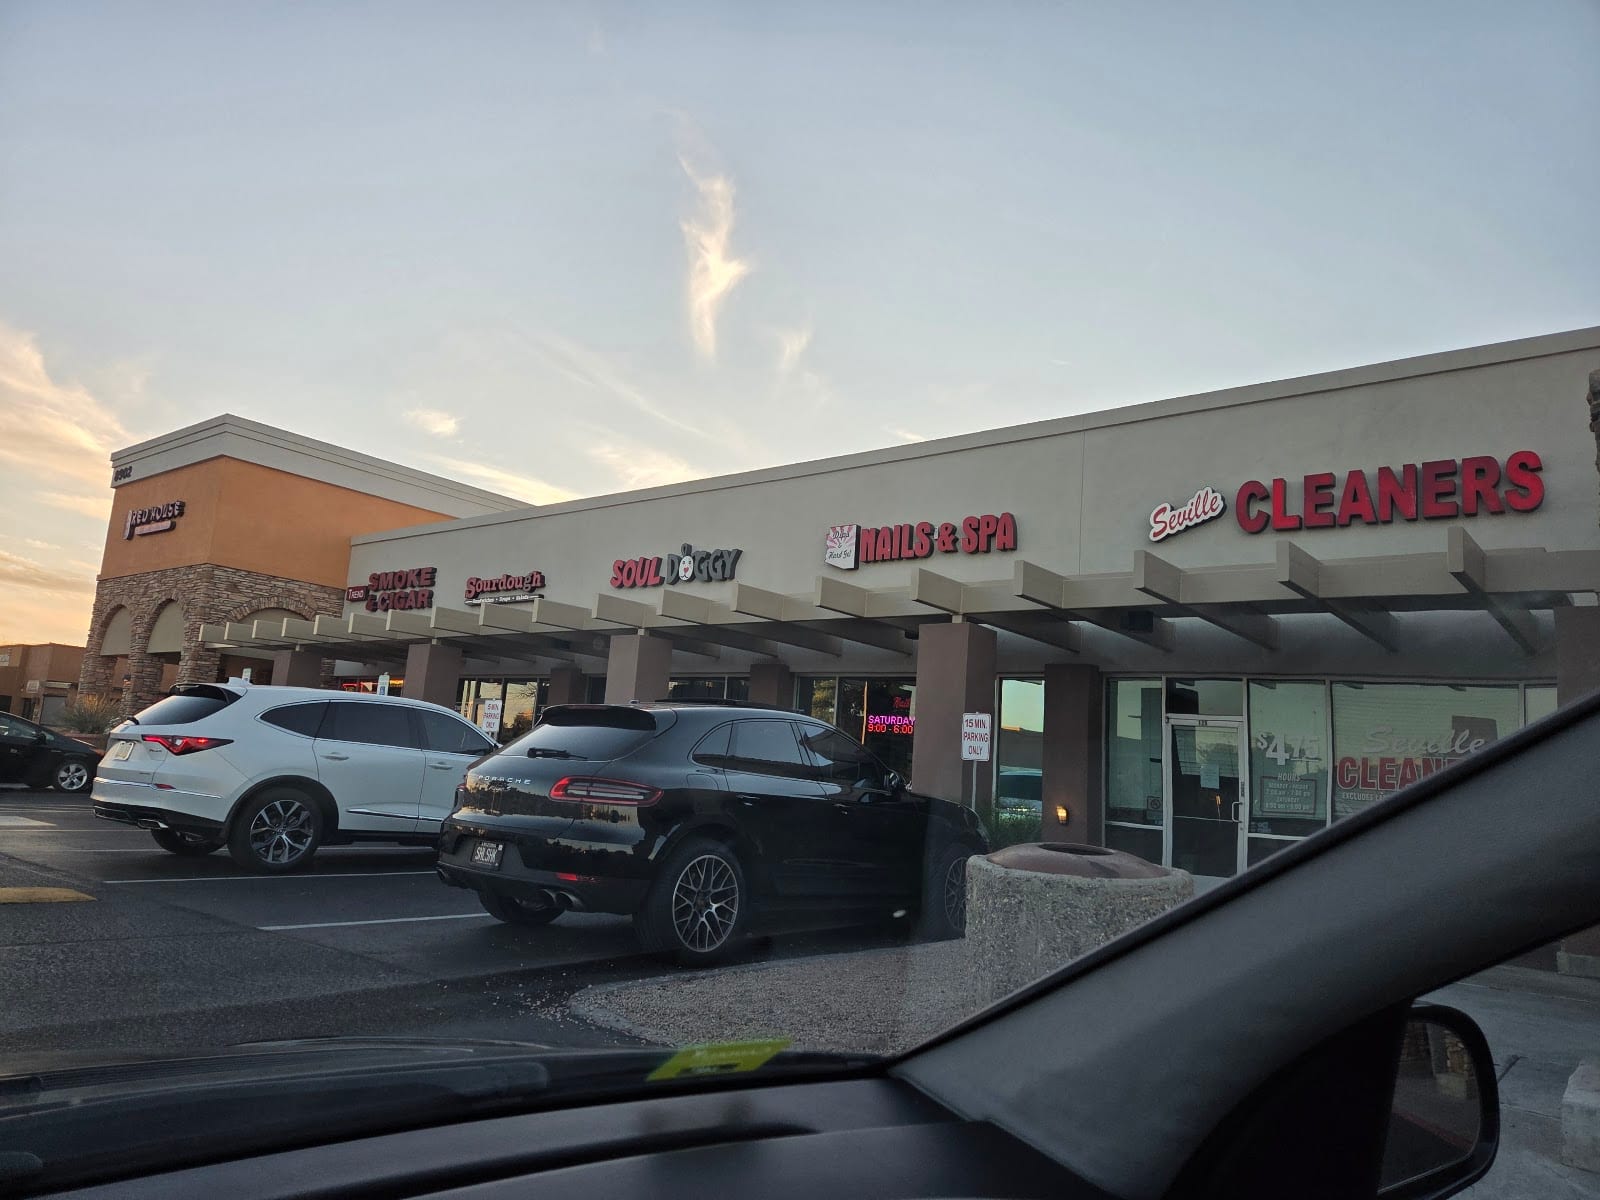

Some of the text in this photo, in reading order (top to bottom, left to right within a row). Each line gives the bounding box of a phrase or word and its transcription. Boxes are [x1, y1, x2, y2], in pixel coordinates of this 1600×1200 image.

[1149, 450, 1546, 542] Seville CLEANERS
[860, 512, 1018, 563] NAILS & SPA
[609, 543, 744, 588] SOUL DOGGY
[369, 567, 437, 591] SMOKE
[465, 571, 545, 599] Sourdough
[378, 589, 434, 612] CIGAR
[867, 724, 887, 733] 9:00
[893, 724, 914, 734] 6:00
[868, 714, 916, 726] SATURDAY
[964, 718, 974, 729] 15
[963, 732, 989, 743] PARKING
[968, 745, 983, 755] ONLY
[478, 774, 531, 785] PORSCHE
[1337, 756, 1463, 792] CLEAN
